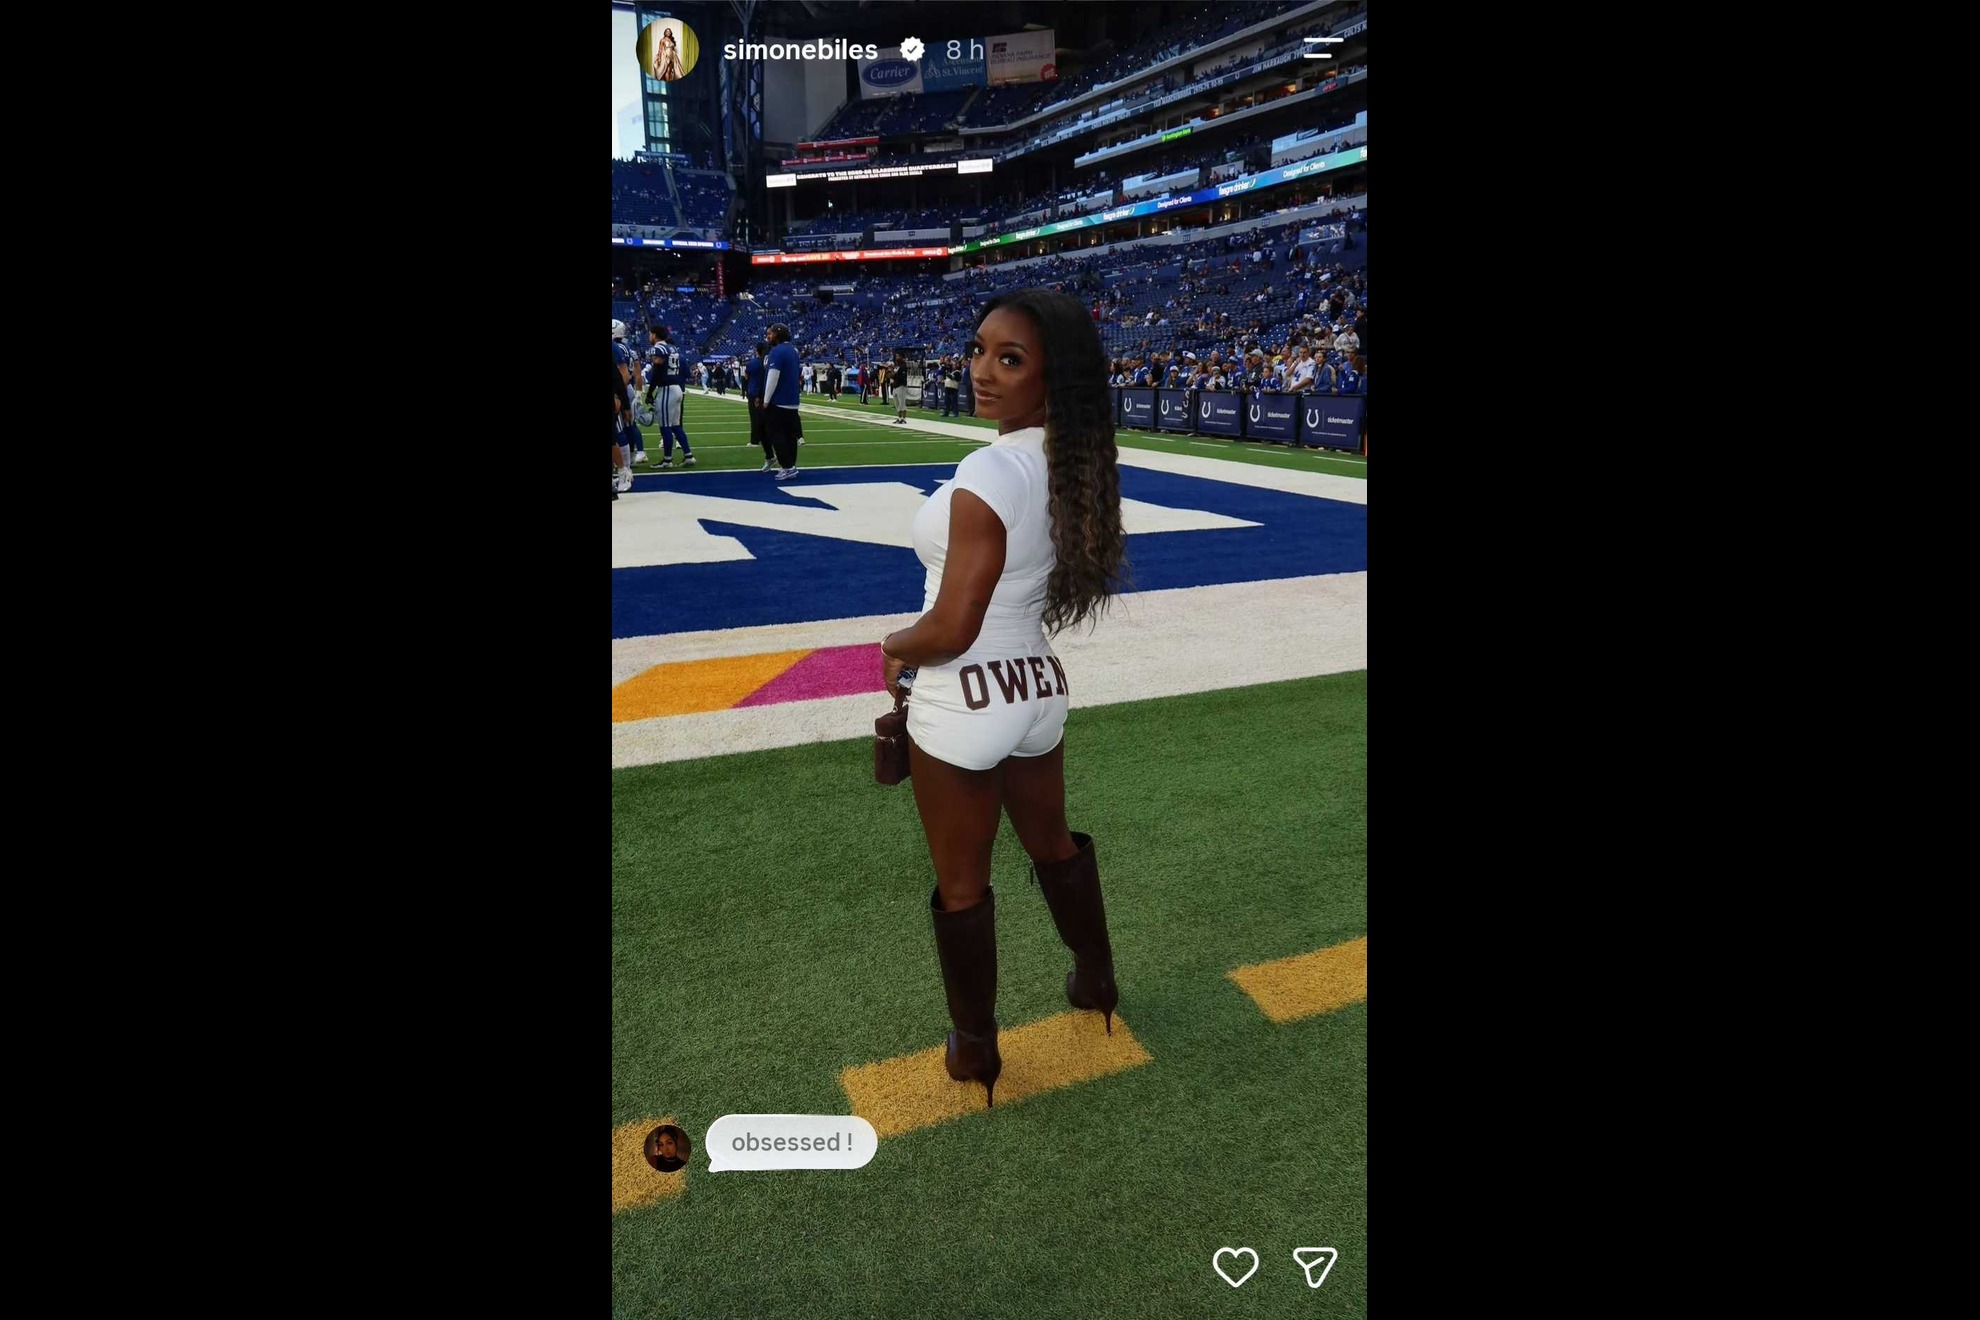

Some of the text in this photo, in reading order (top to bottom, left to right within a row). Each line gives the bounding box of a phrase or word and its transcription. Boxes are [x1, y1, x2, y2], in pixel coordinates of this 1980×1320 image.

[870, 66, 910, 80] Carrier
[1283, 167, 1303, 179] Designed
[1310, 161, 1326, 171] Clients
[1327, 416, 1354, 425] ticketmaster
[959, 655, 1069, 711] OWEN
